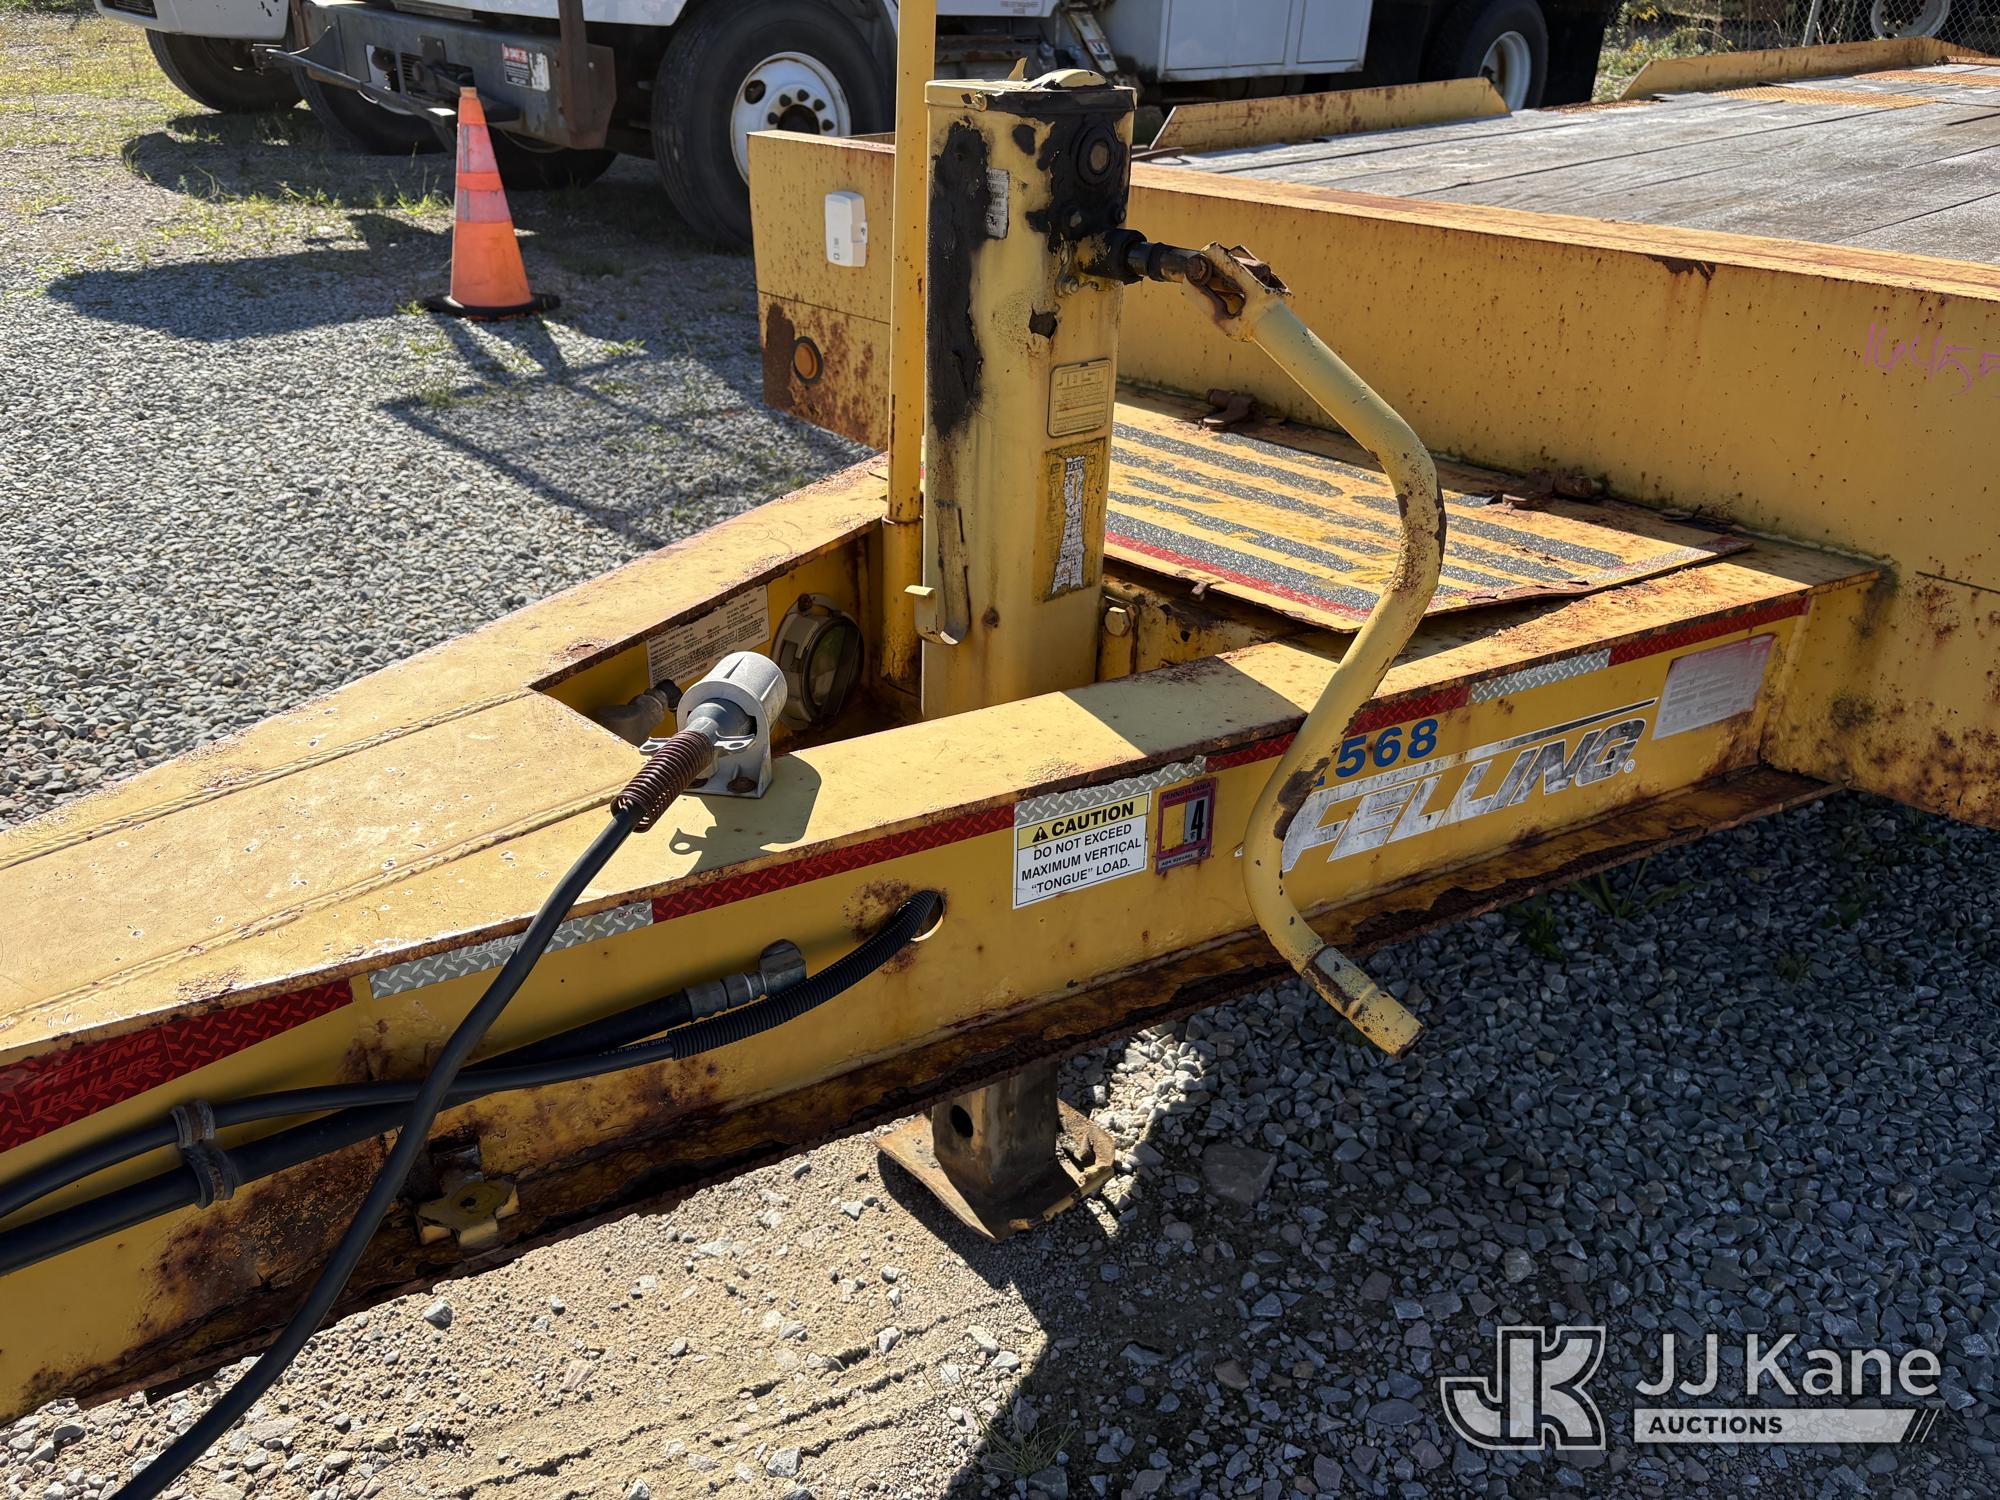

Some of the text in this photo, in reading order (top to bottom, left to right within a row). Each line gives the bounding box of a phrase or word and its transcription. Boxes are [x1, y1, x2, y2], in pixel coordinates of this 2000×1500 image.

[1315, 718, 1438, 786] 568
[1161, 782, 1212, 800] PENNSYLVANIA
[1282, 718, 1648, 872] FELLING
[1051, 802, 1134, 837] CAUTION
[1021, 853, 1081, 882] MAXIMUM
[1084, 838, 1142, 863] VERTICAL
[1033, 823, 1132, 861] DO NOT EXCEED
[1031, 858, 1131, 894] “TONGUE” LOAD.
[30, 1033, 158, 1096] FELLING
[31, 1052, 161, 1117] TRAILERS
